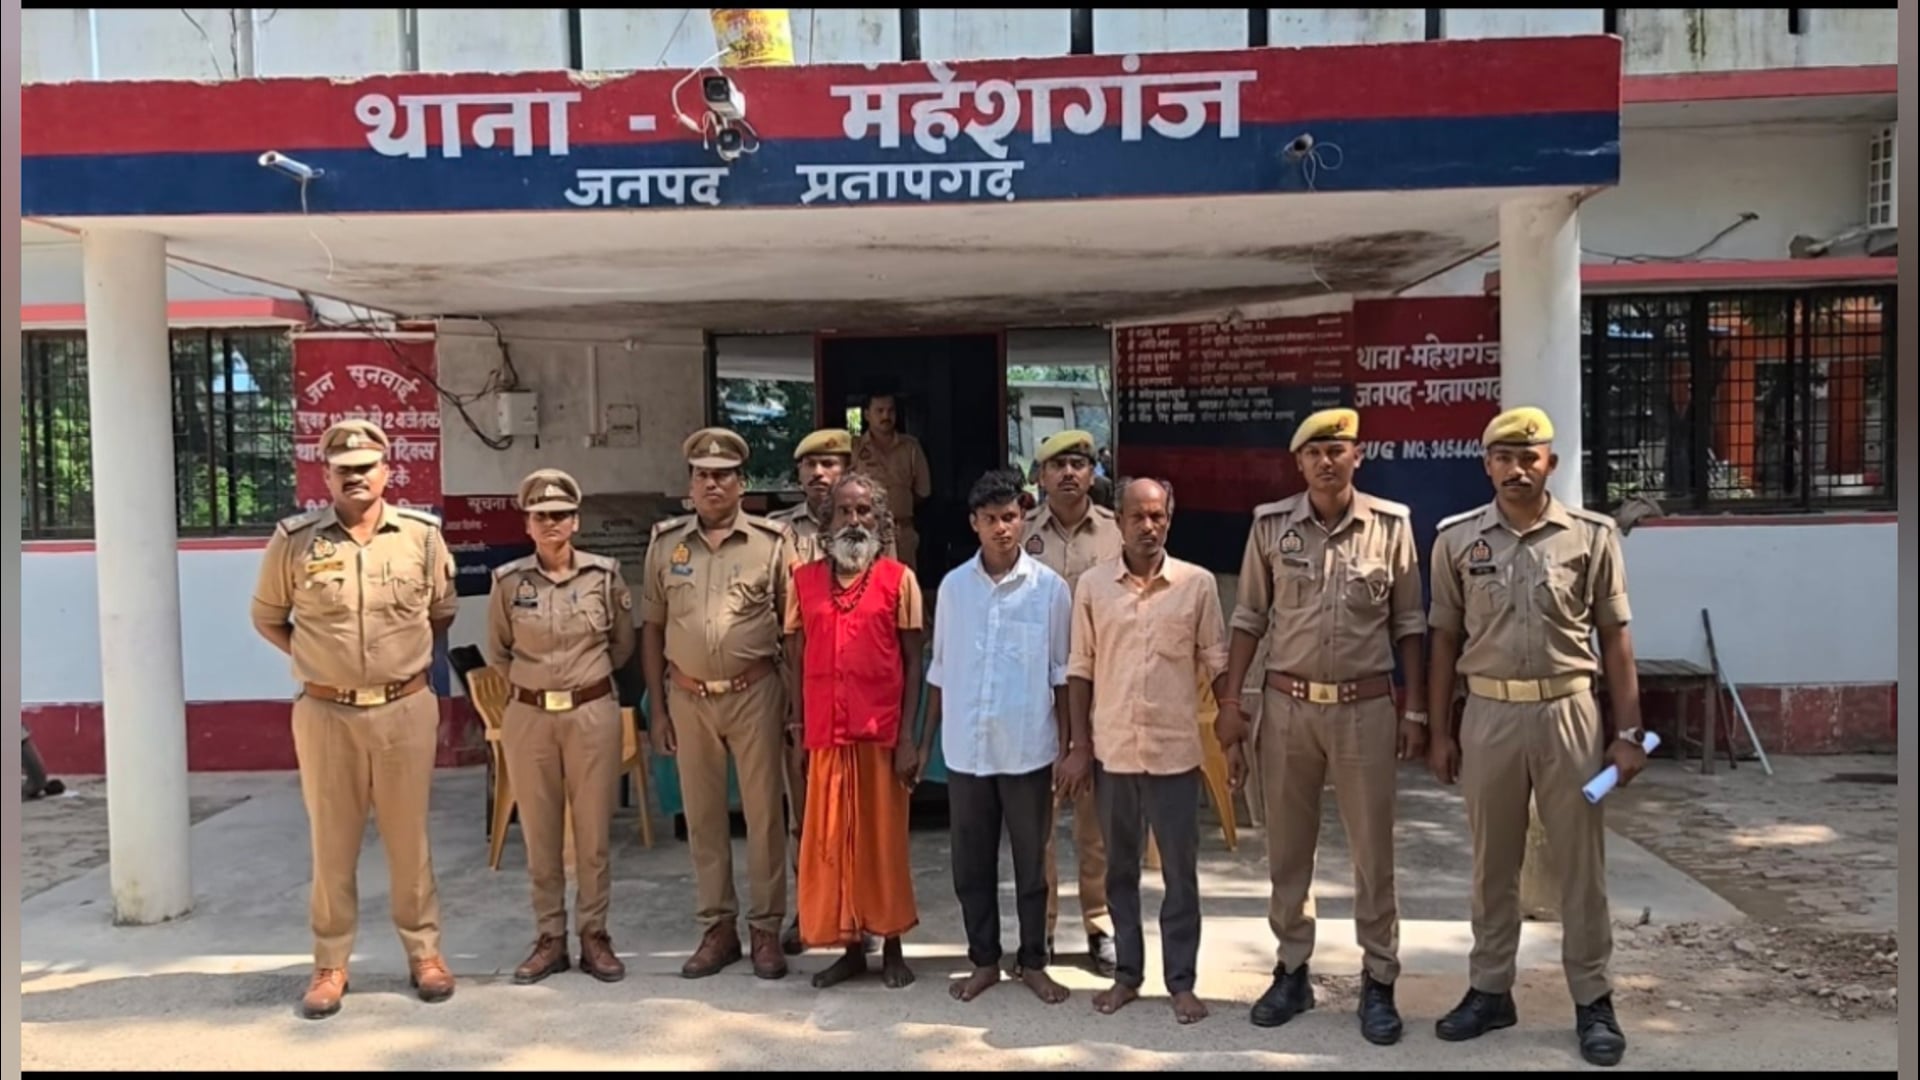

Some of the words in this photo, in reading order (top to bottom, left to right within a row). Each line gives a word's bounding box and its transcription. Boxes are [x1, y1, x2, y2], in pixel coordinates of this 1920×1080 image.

[355, 91, 582, 159] थाना
[564, 166, 730, 207] जनपद
[303, 371, 336, 405] जन
[346, 364, 421, 405] सुनवाई
[384, 412, 395, 429] 2
[466, 496, 508, 514] सूचना
